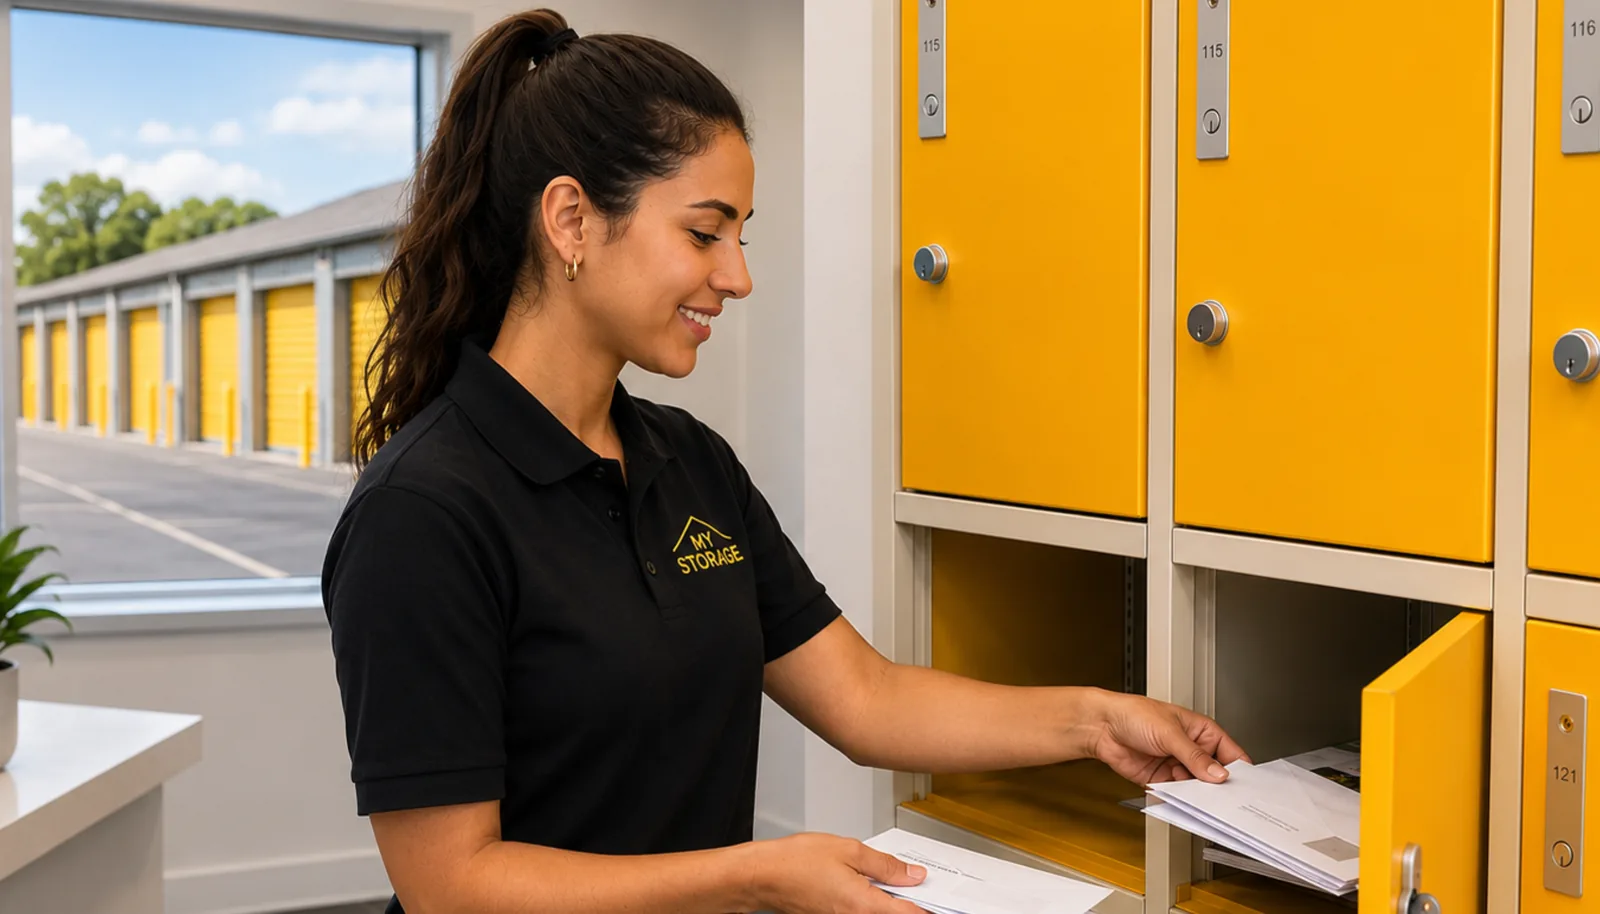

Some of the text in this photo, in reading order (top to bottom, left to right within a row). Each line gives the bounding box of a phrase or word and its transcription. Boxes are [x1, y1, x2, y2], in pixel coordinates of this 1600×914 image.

[1571, 19, 1596, 37] 116
[923, 38, 941, 53] 115
[1202, 43, 1223, 59] 115
[689, 530, 714, 551] MY
[676, 544, 744, 575] STORAGE
[1553, 765, 1576, 784] 121
